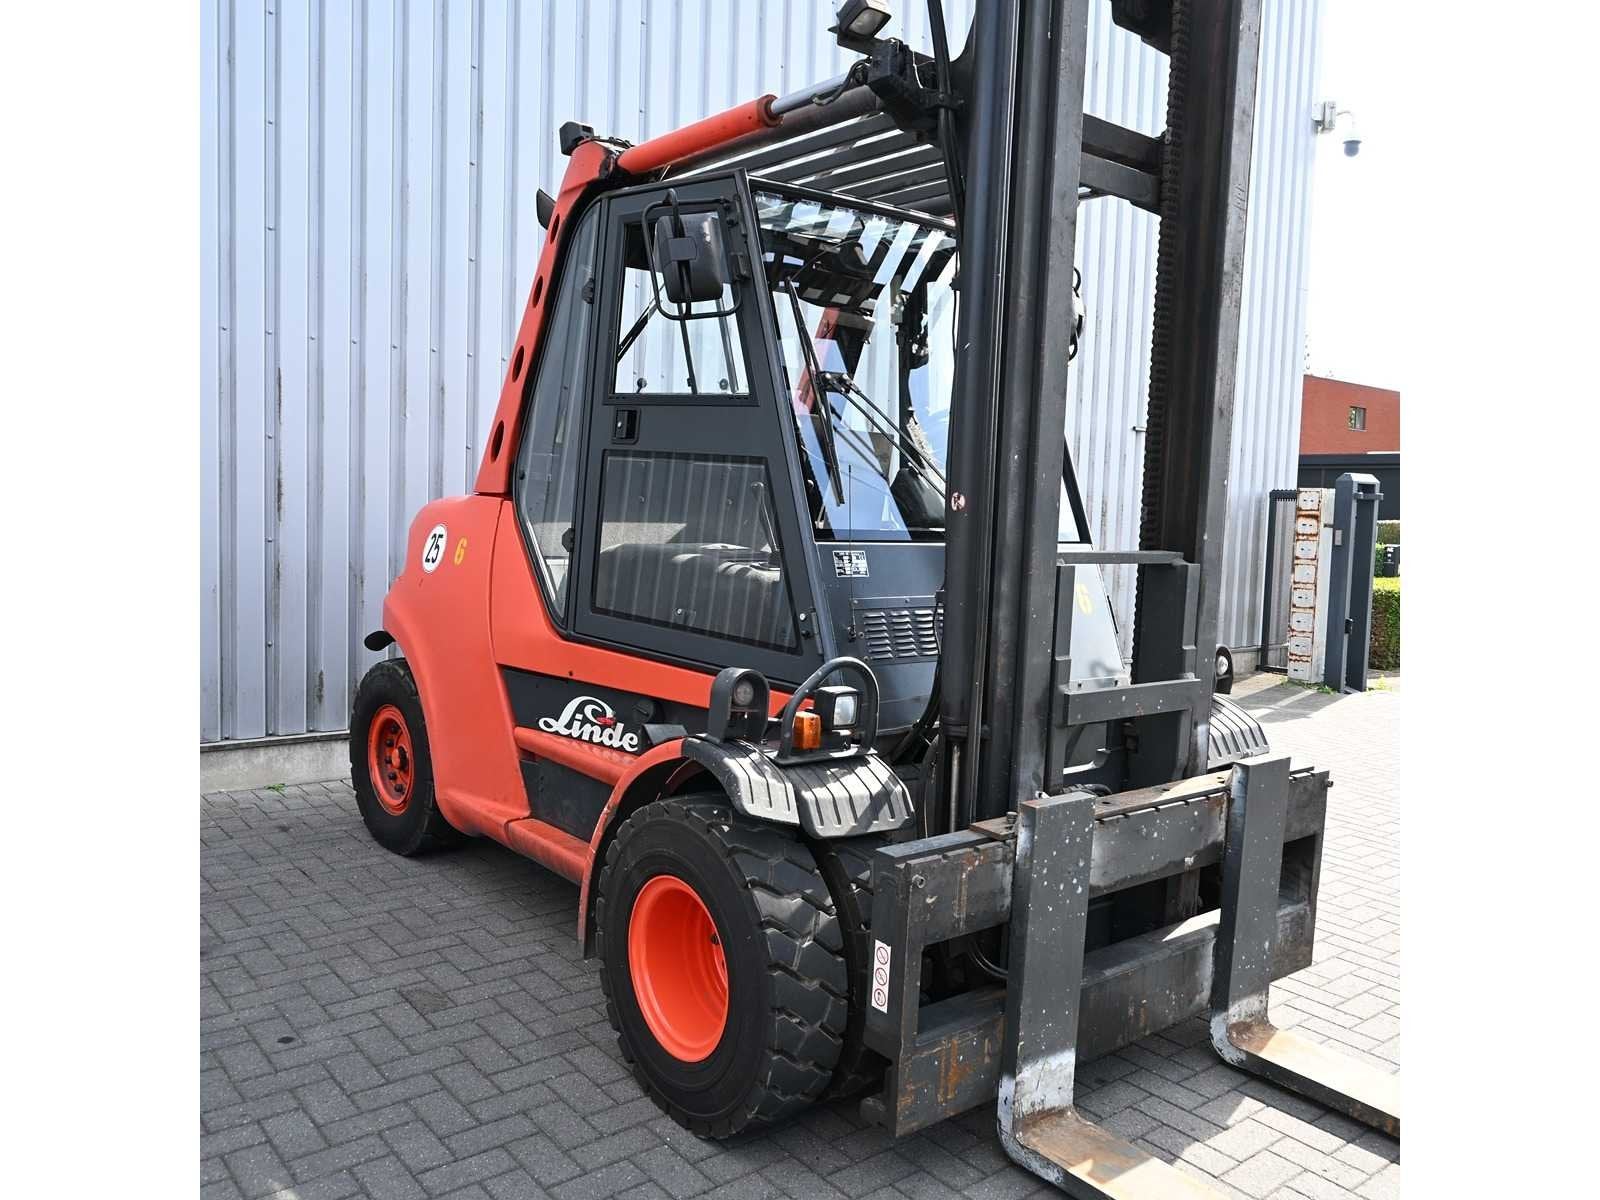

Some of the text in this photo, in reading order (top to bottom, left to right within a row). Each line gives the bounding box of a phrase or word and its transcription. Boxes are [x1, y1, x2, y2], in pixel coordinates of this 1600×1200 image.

[424, 533, 444, 563] 25
[454, 537, 468, 566] 6
[1075, 583, 1093, 615] 6
[538, 695, 639, 752] Linde
